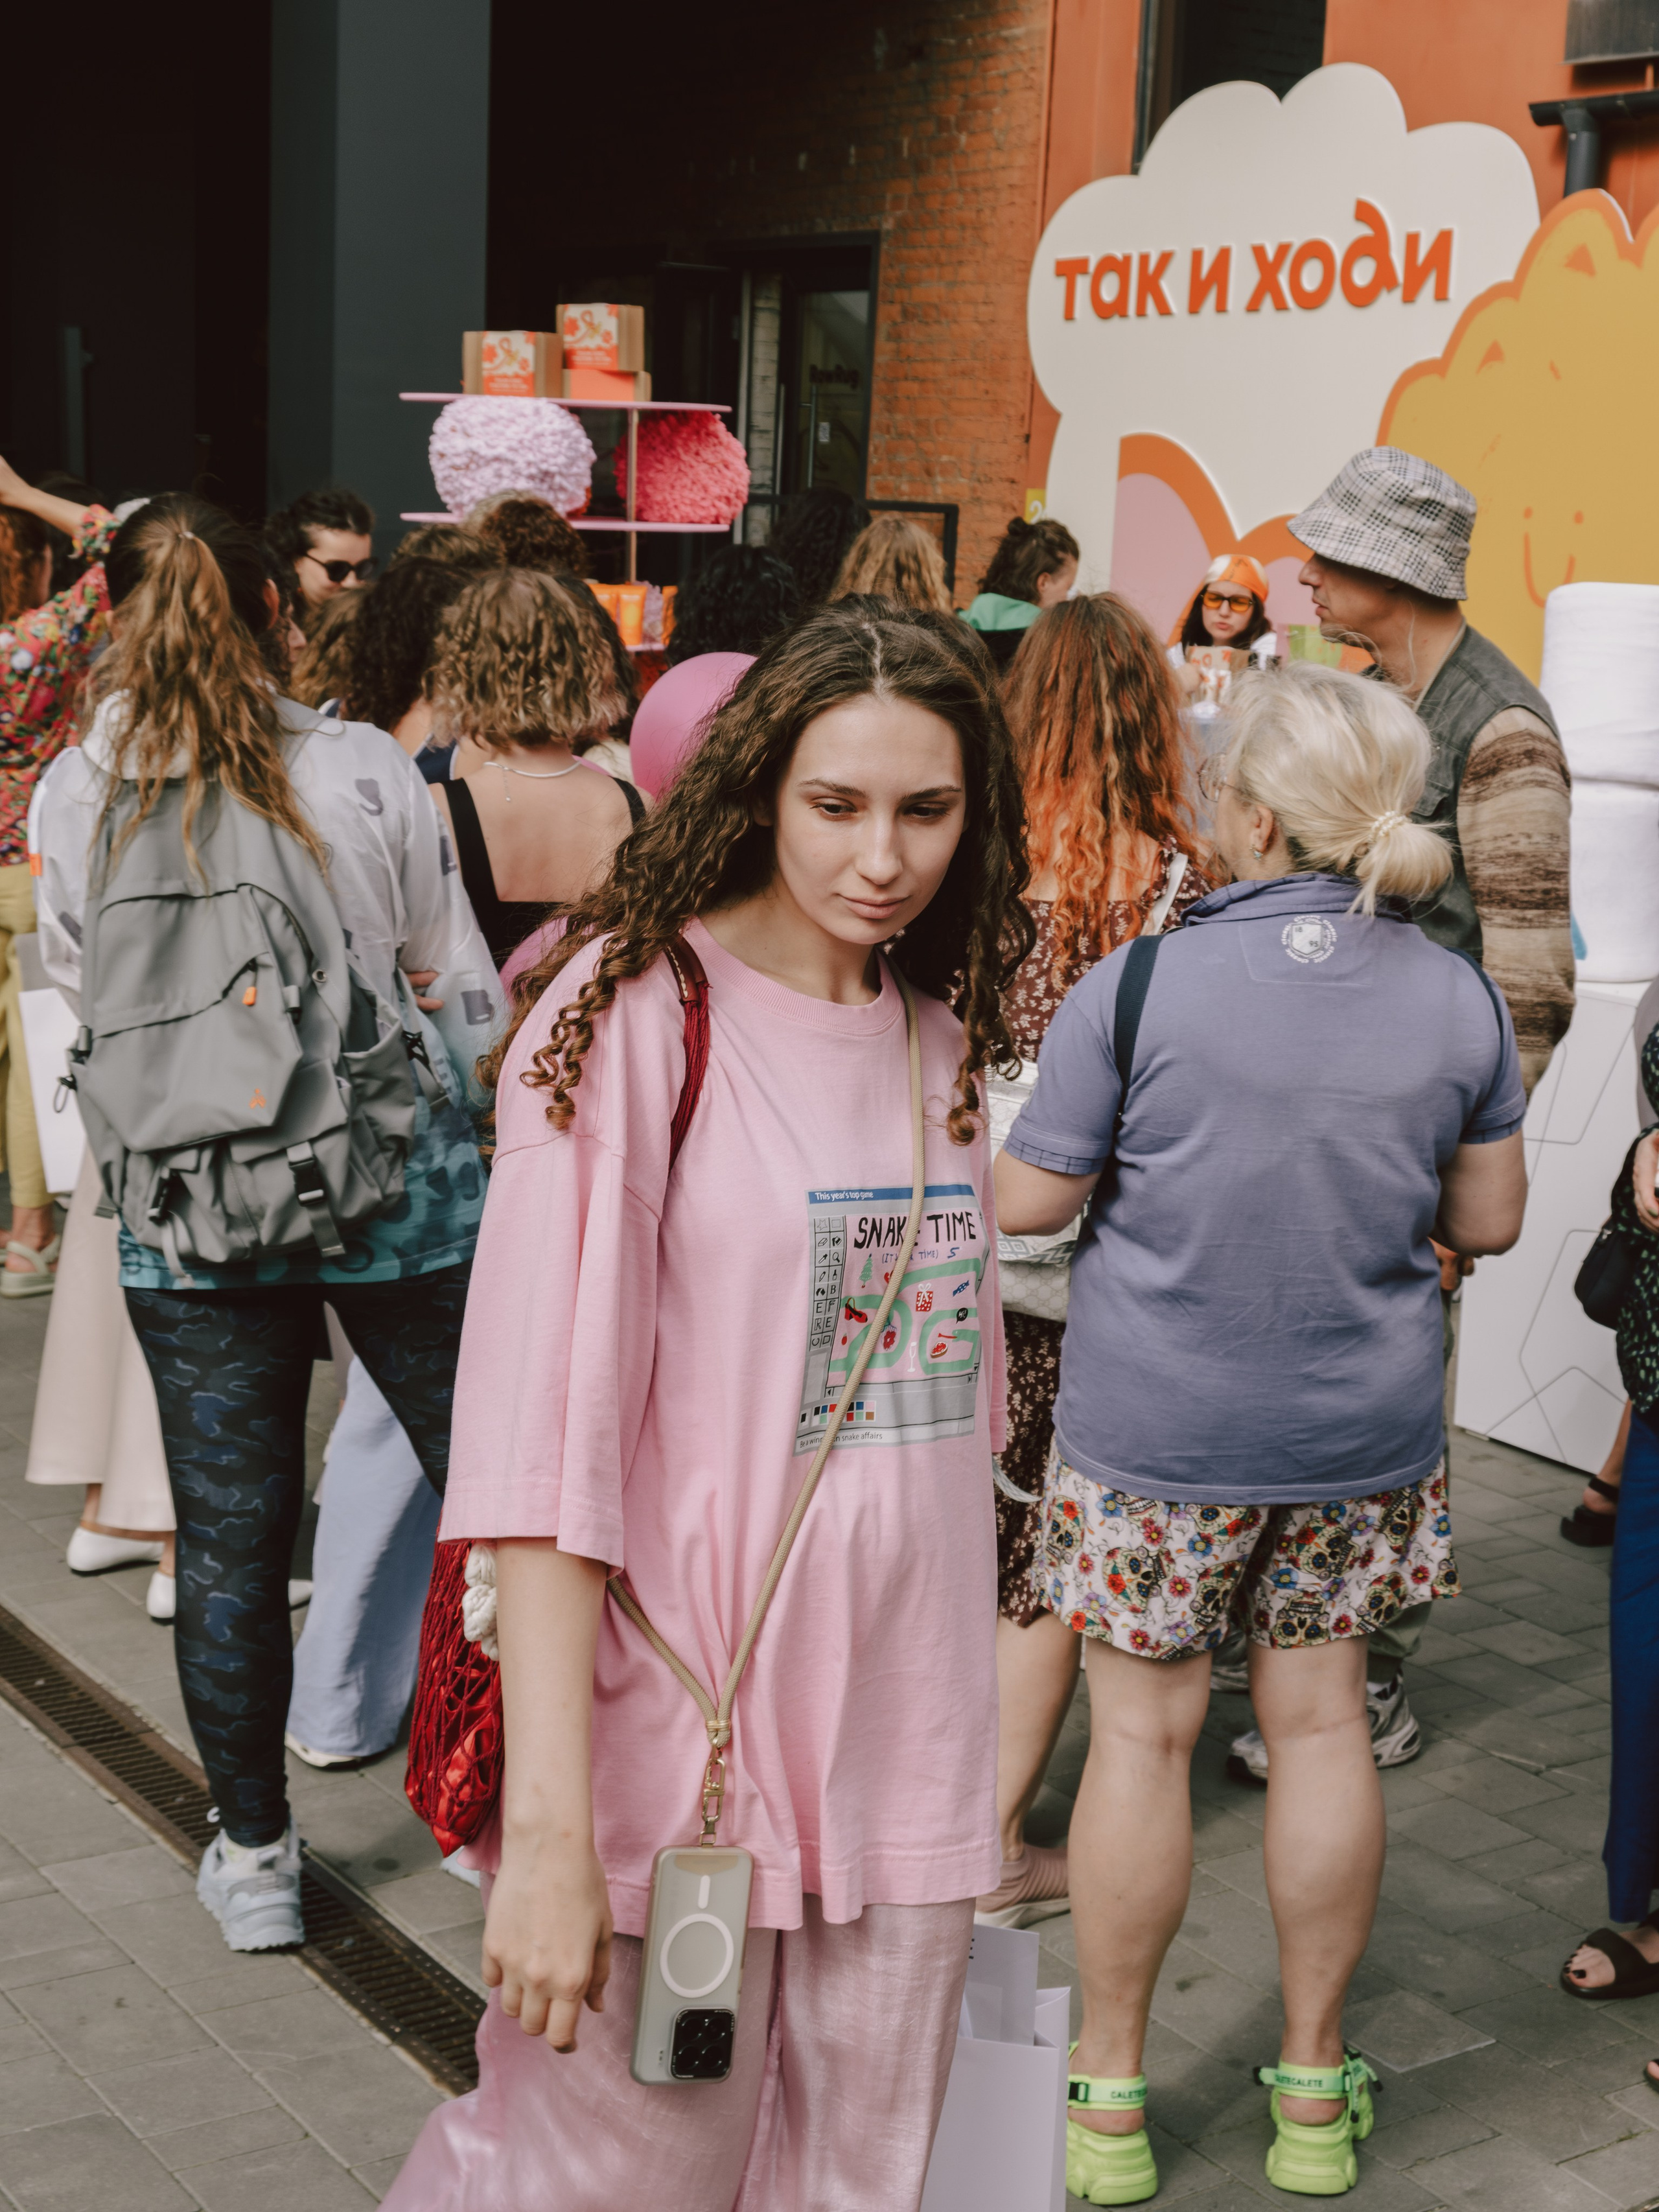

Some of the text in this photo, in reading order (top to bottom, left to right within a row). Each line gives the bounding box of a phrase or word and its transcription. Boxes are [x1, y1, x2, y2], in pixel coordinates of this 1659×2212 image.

[1054, 197, 1454, 321] так и ходи
[815, 1191, 830, 1200] This
[830, 1191, 850, 1202] year's
[850, 1191, 860, 1200] top
[927, 1211, 976, 1243] TIME
[830, 1285, 836, 1294] B
[816, 1299, 836, 1314] E F
[814, 1316, 832, 1331] R E
[842, 1433, 859, 1442] snake
[861, 1432, 883, 1440] affairs
